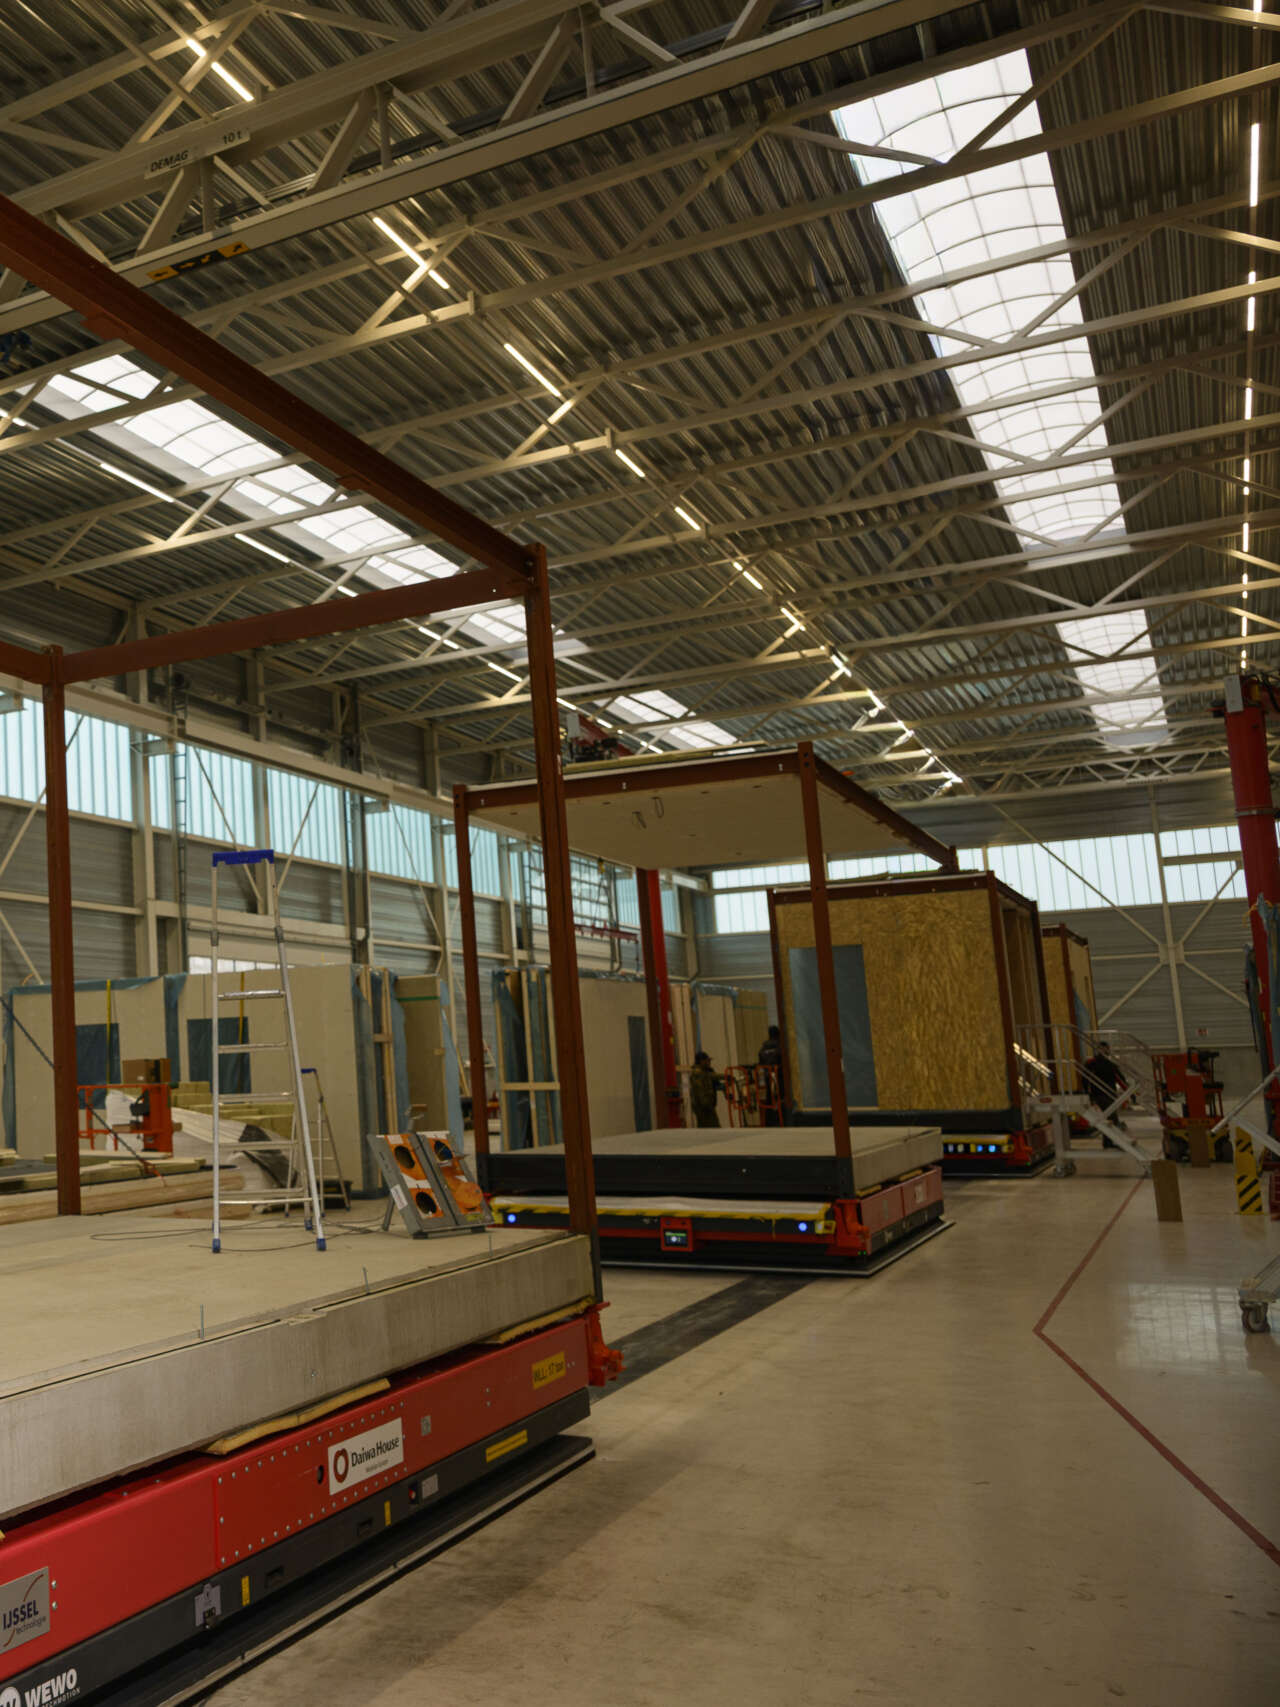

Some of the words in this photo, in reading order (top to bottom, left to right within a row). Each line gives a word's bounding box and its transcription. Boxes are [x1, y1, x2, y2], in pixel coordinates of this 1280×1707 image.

[223, 132, 235, 144] 10
[150, 150, 189, 172] DEMAG
[351, 1446, 376, 1467] Daiwa
[376, 1437, 400, 1456] House
[3, 1599, 39, 1630] IJSSEL
[24, 1668, 78, 1707] WEWO
